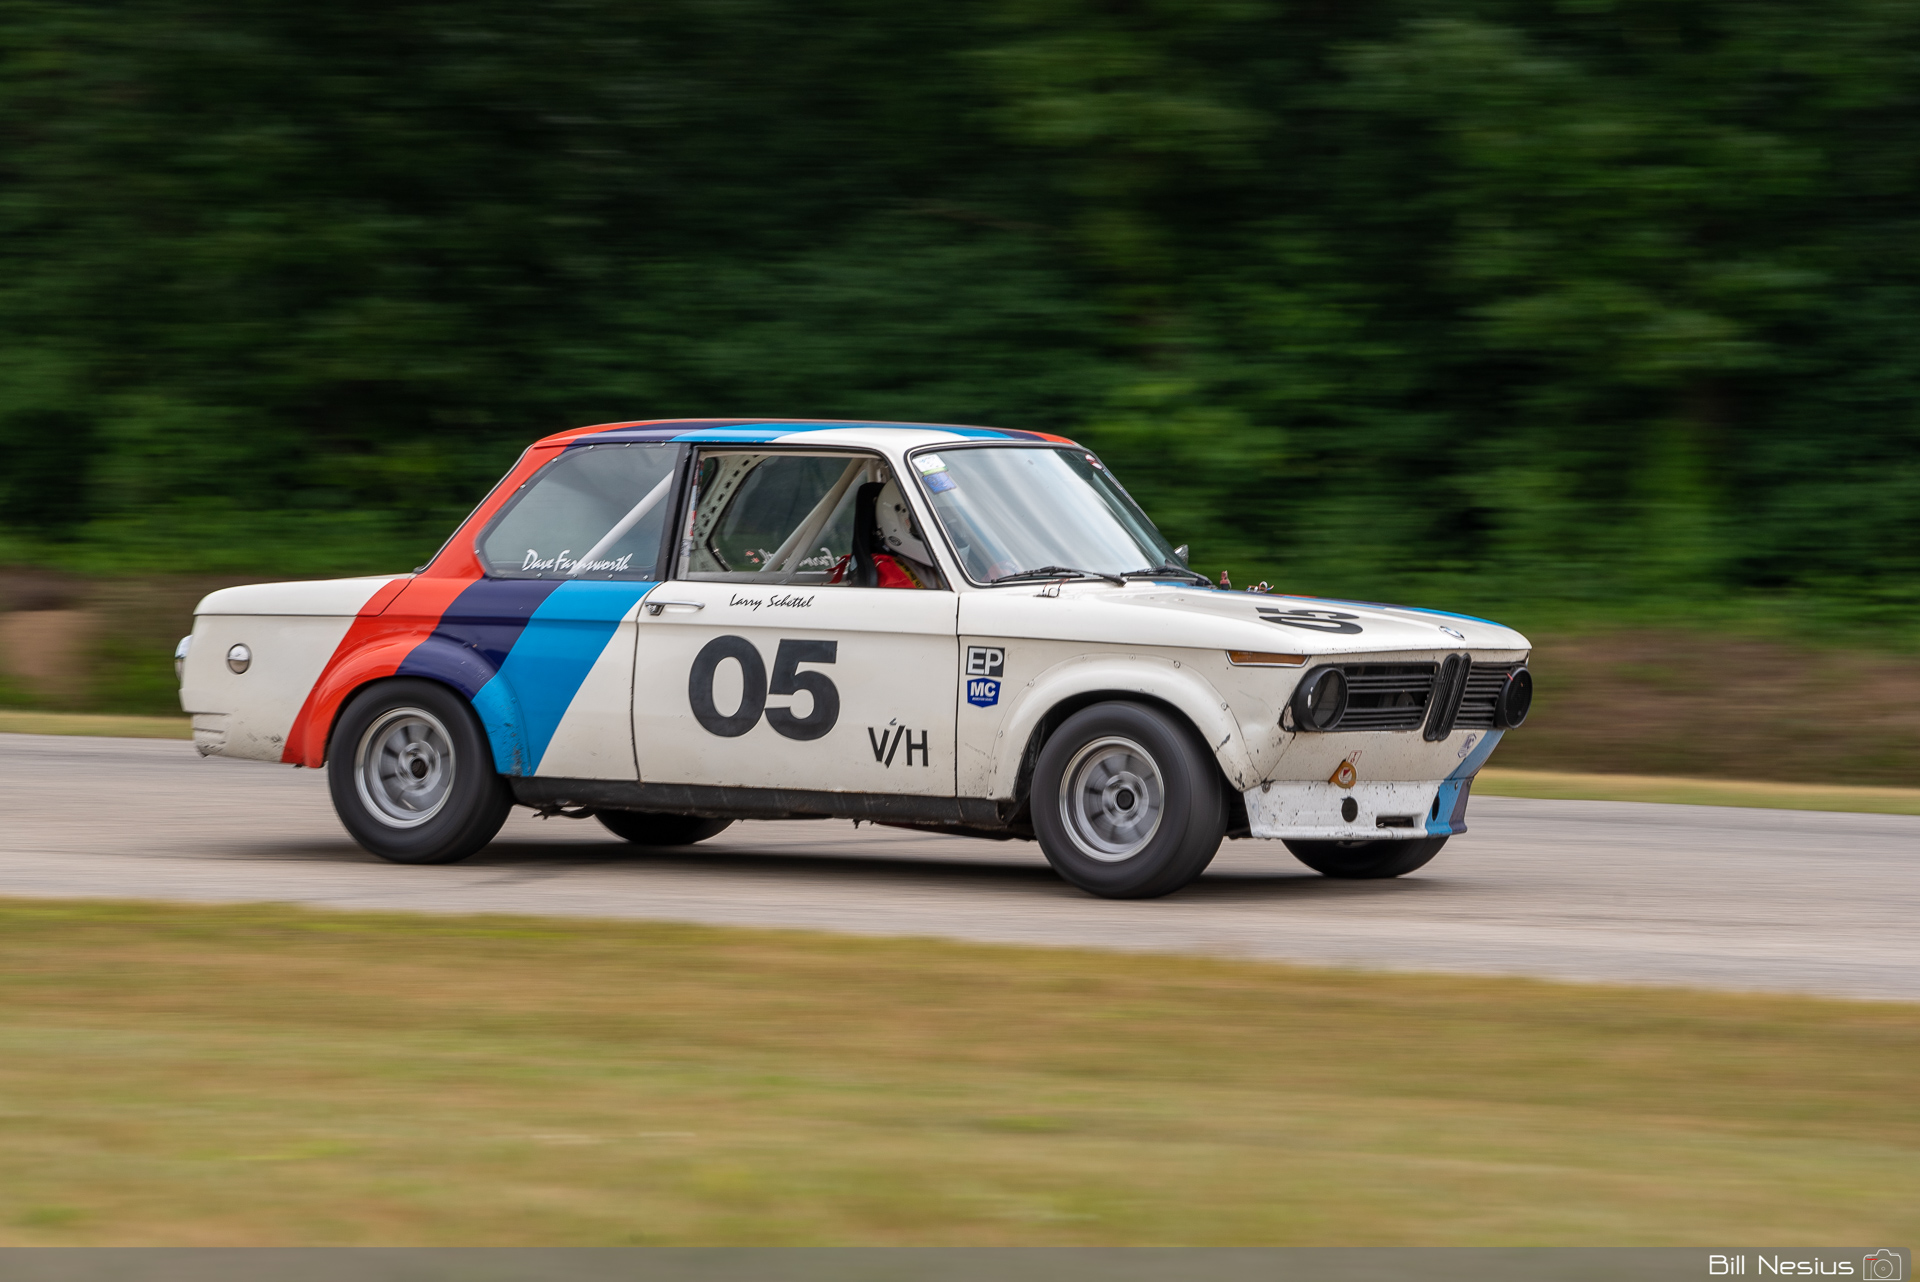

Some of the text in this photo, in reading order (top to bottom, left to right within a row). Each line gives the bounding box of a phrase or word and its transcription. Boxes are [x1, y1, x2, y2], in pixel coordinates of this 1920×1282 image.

[521, 549, 631, 571] Dave Farnsworth
[729, 593, 815, 611] Larry Schettel
[1255, 607, 1363, 634] 05
[967, 647, 1003, 675] EP
[689, 635, 840, 741] 05
[970, 682, 996, 697] MC
